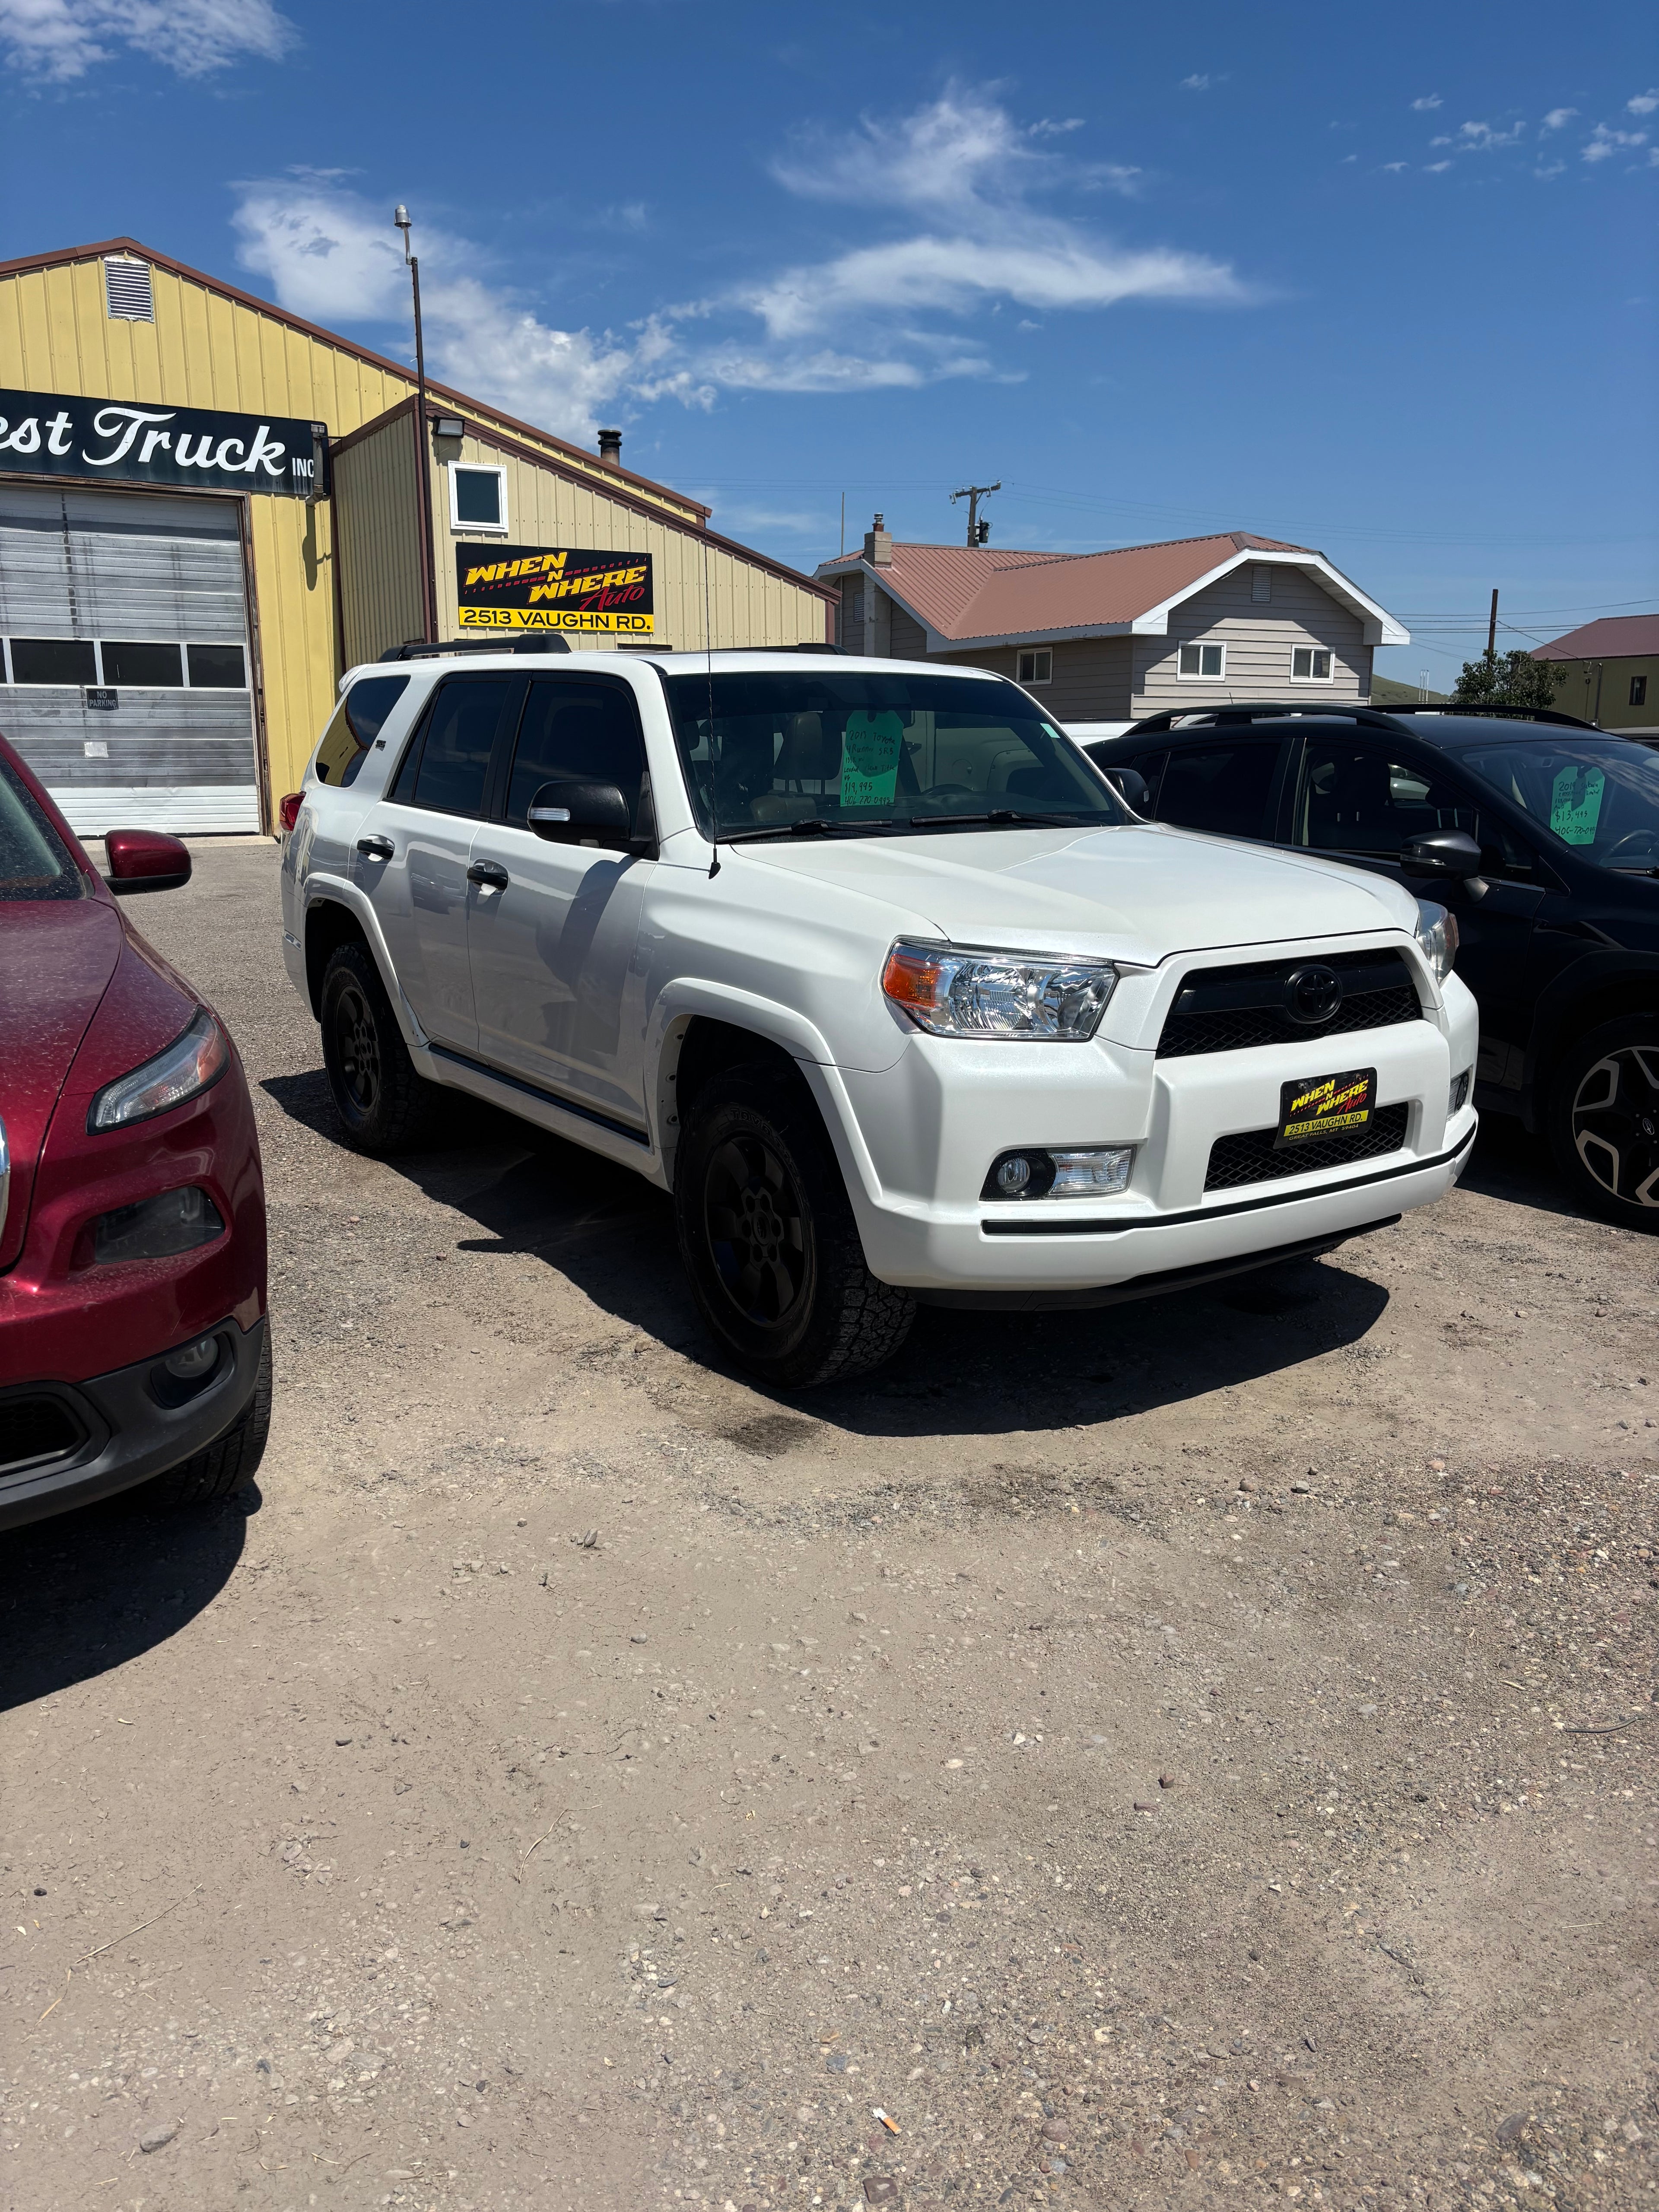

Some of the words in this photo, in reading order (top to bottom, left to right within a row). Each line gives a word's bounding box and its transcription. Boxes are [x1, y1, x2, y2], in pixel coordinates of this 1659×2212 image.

[82, 407, 286, 476] Truck
[464, 551, 568, 587] WHEN
[547, 569, 564, 582] N
[527, 566, 647, 604] WHERE
[579, 585, 645, 611] Auto
[464, 610, 512, 625] 2513
[517, 612, 609, 629] VAUGHN
[616, 616, 651, 630] RD.
[873, 732, 896, 744] Toyota
[879, 747, 893, 755] SR5
[1558, 781, 1576, 791] 2019
[1555, 810, 1587, 823] $13,495
[1291, 1080, 1335, 1112] WHEN
[1316, 1080, 1368, 1115] WHERE
[1325, 1091, 1333, 1100] N
[1337, 1093, 1367, 1115] Auto
[1289, 1123, 1309, 1134] 2513
[1311, 1116, 1348, 1130] VAUGHN
[1349, 1113, 1363, 1122] RD.
